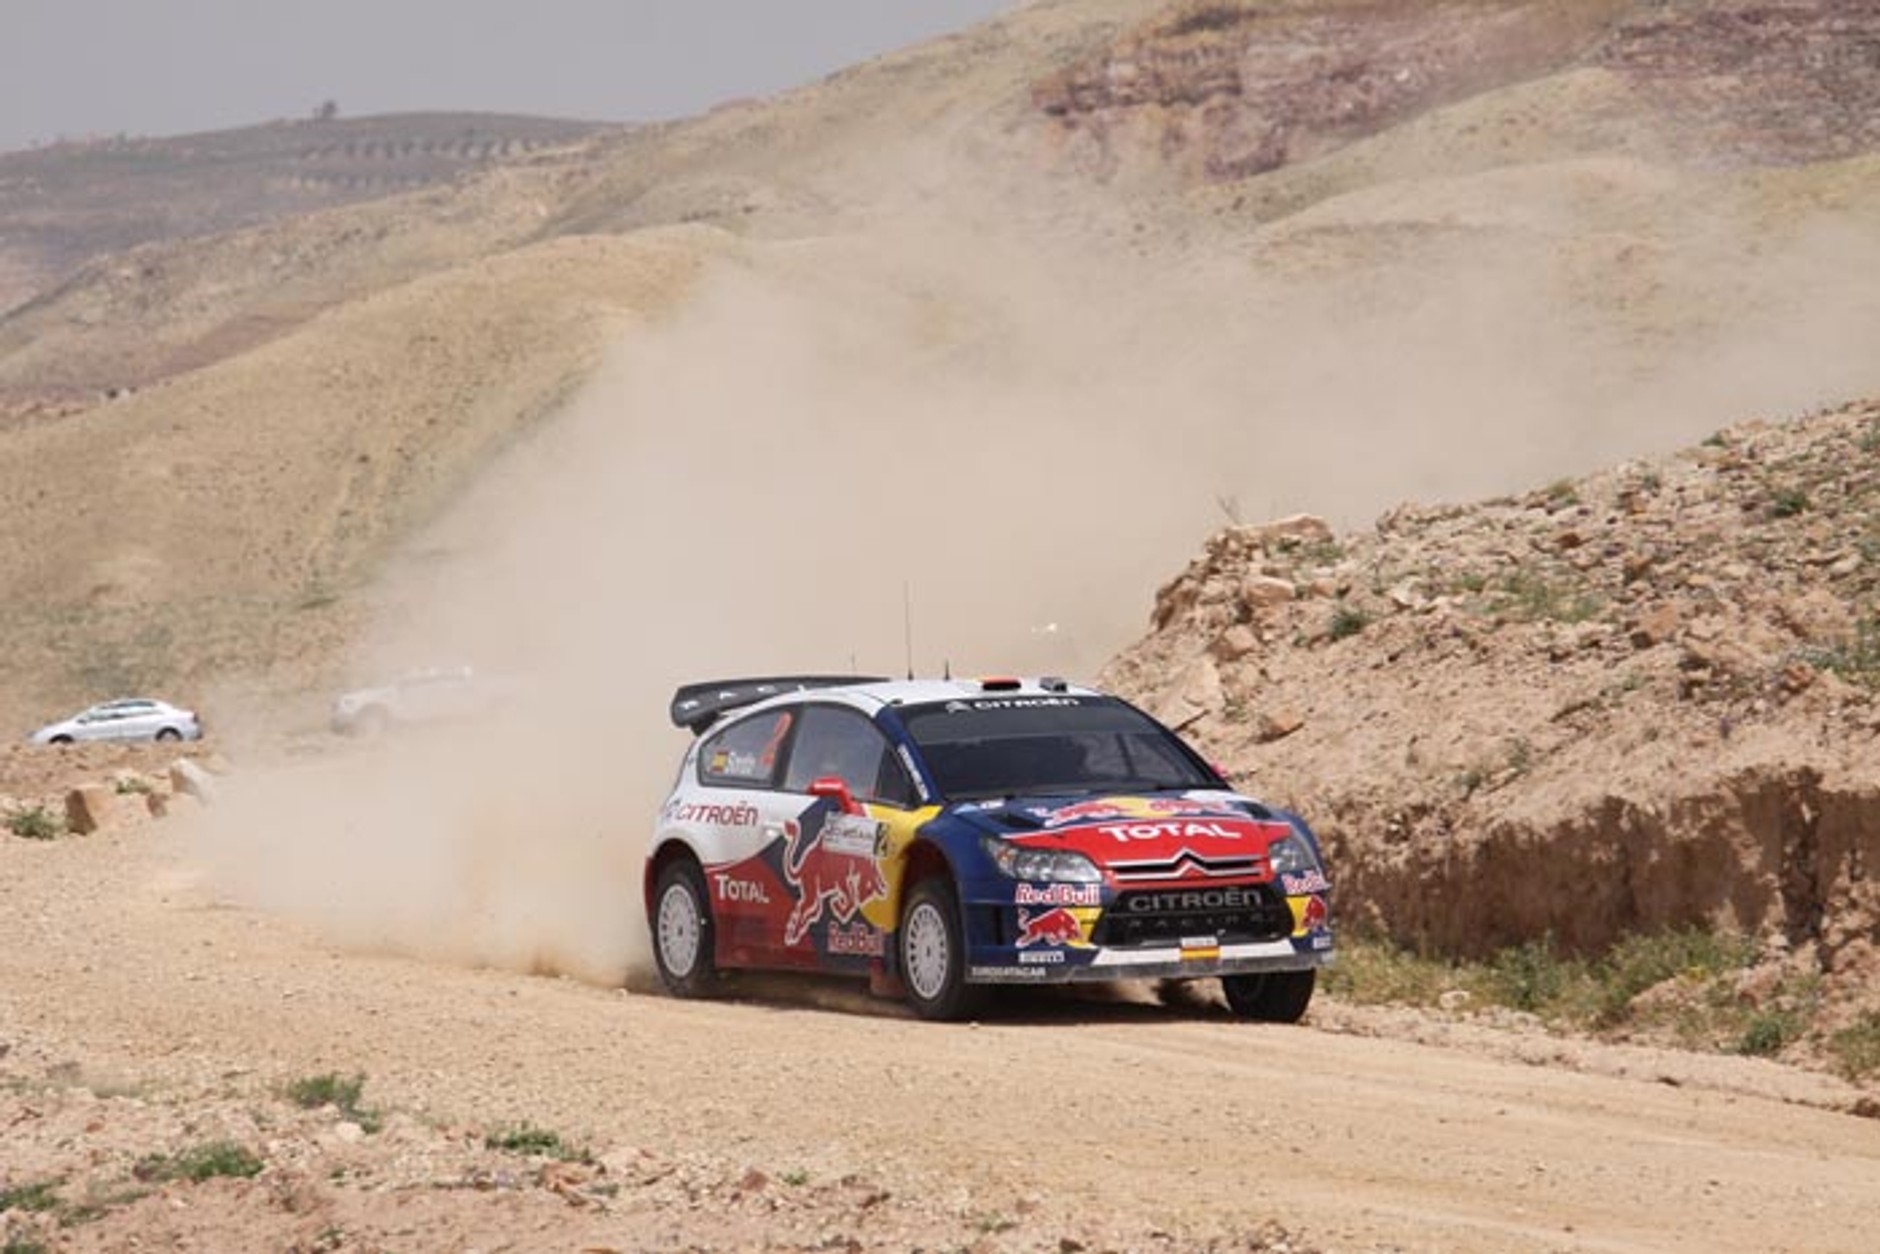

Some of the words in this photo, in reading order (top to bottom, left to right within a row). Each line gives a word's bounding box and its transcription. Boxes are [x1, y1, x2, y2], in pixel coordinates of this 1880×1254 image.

[676, 801, 759, 827] CITROËN
[1098, 823, 1242, 842] TOTAL
[1015, 883, 1059, 904] Red
[1059, 883, 1100, 904] Bull
[1128, 886, 1262, 912] CITROËN
